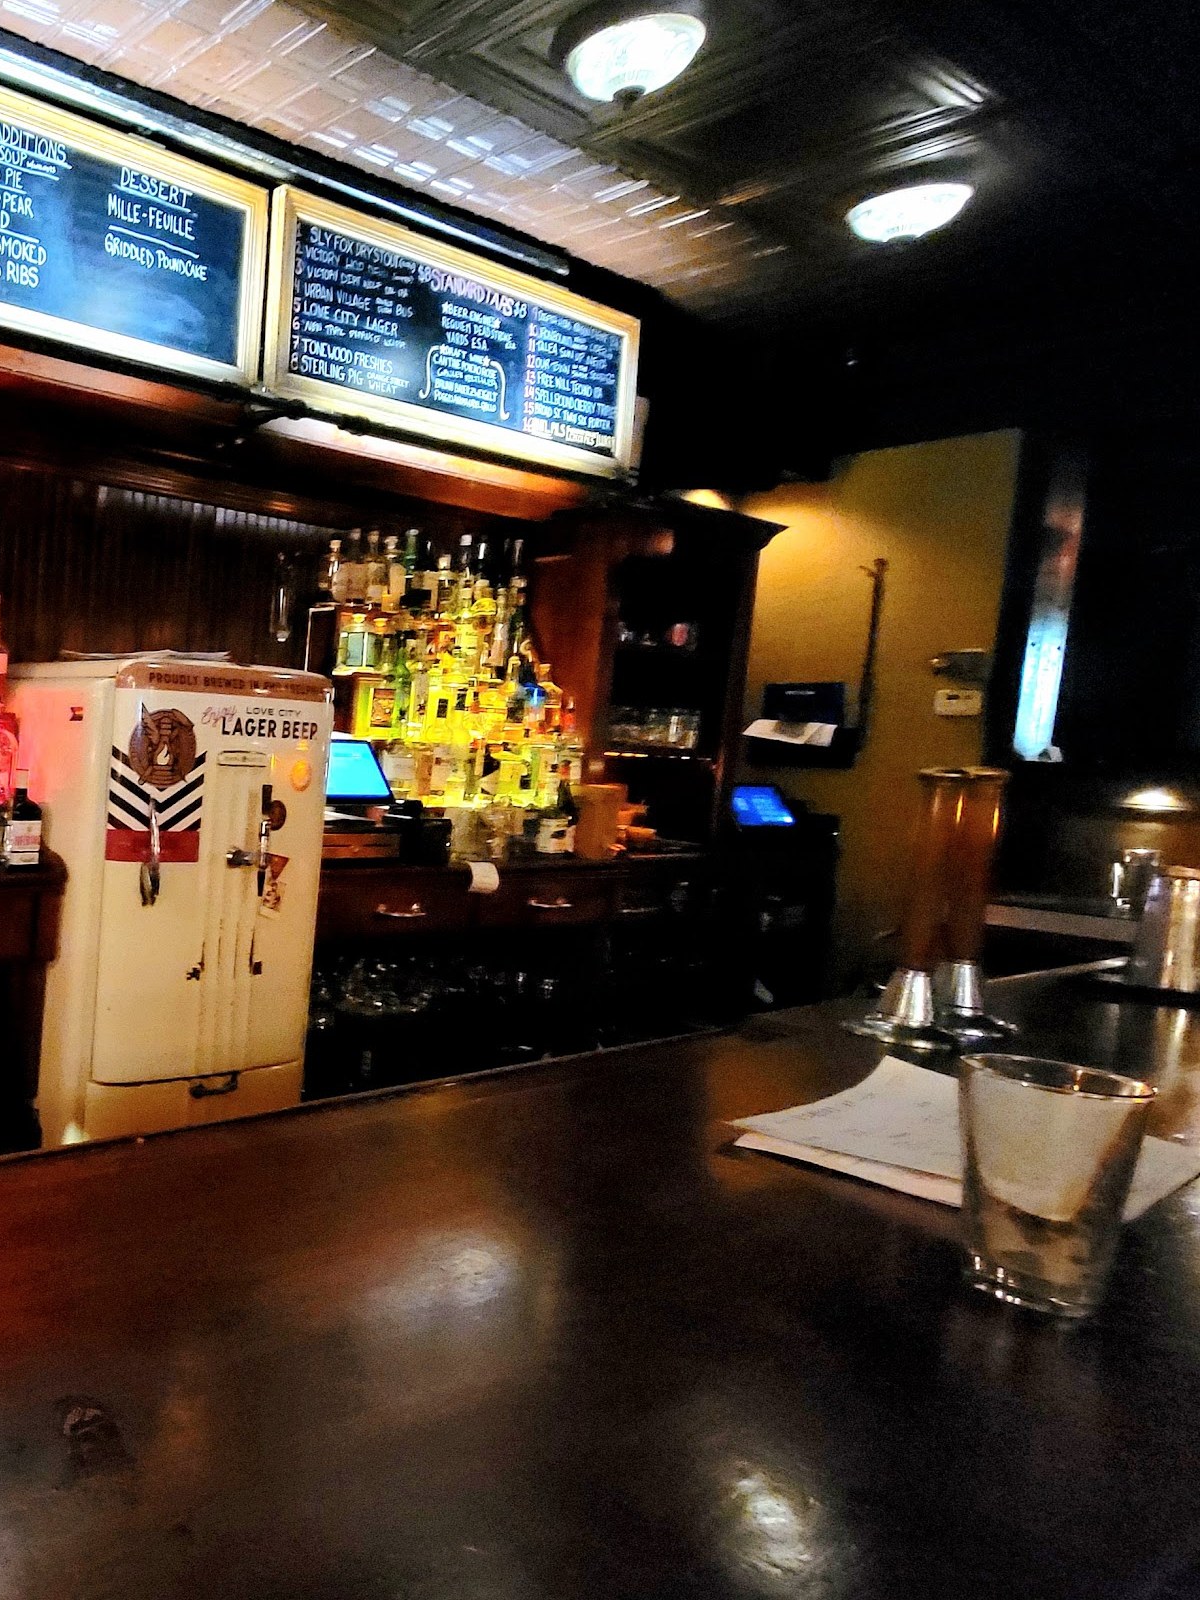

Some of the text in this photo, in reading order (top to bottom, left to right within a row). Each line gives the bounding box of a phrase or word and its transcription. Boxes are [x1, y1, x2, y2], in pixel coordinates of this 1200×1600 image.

[0, 145, 27, 166] SOUP
[5, 168, 23, 189] PIE
[121, 167, 193, 208] DESSERT
[3, 191, 34, 218] PEAR
[108, 194, 195, 240] MILLE-FEUILLE
[310, 226, 332, 248] SLY
[333, 235, 354, 255] FOX
[105, 233, 207, 281] GRIDDLED POUNDCAKE
[305, 245, 340, 266] VICTORY
[7, 261, 39, 288] RIBS
[307, 265, 338, 282] VICTORY
[430, 268, 485, 303] STANDARD
[305, 282, 334, 302] URBAN
[337, 288, 371, 312] VILLAGE
[303, 300, 331, 318] LOVE
[334, 308, 360, 327] CITY
[366, 316, 398, 338] LAGER
[301, 354, 346, 381] STERLING
[348, 369, 363, 386] PIG
[302, 338, 352, 364] TONEWOOD
[353, 352, 393, 375] FRESHIES
[368, 379, 398, 395] WHEAT
[149, 672, 198, 686] PROUDLY
[203, 676, 246, 689] BREWED
[246, 707, 303, 717] LOVE CITY
[221, 716, 277, 738] LAGER
